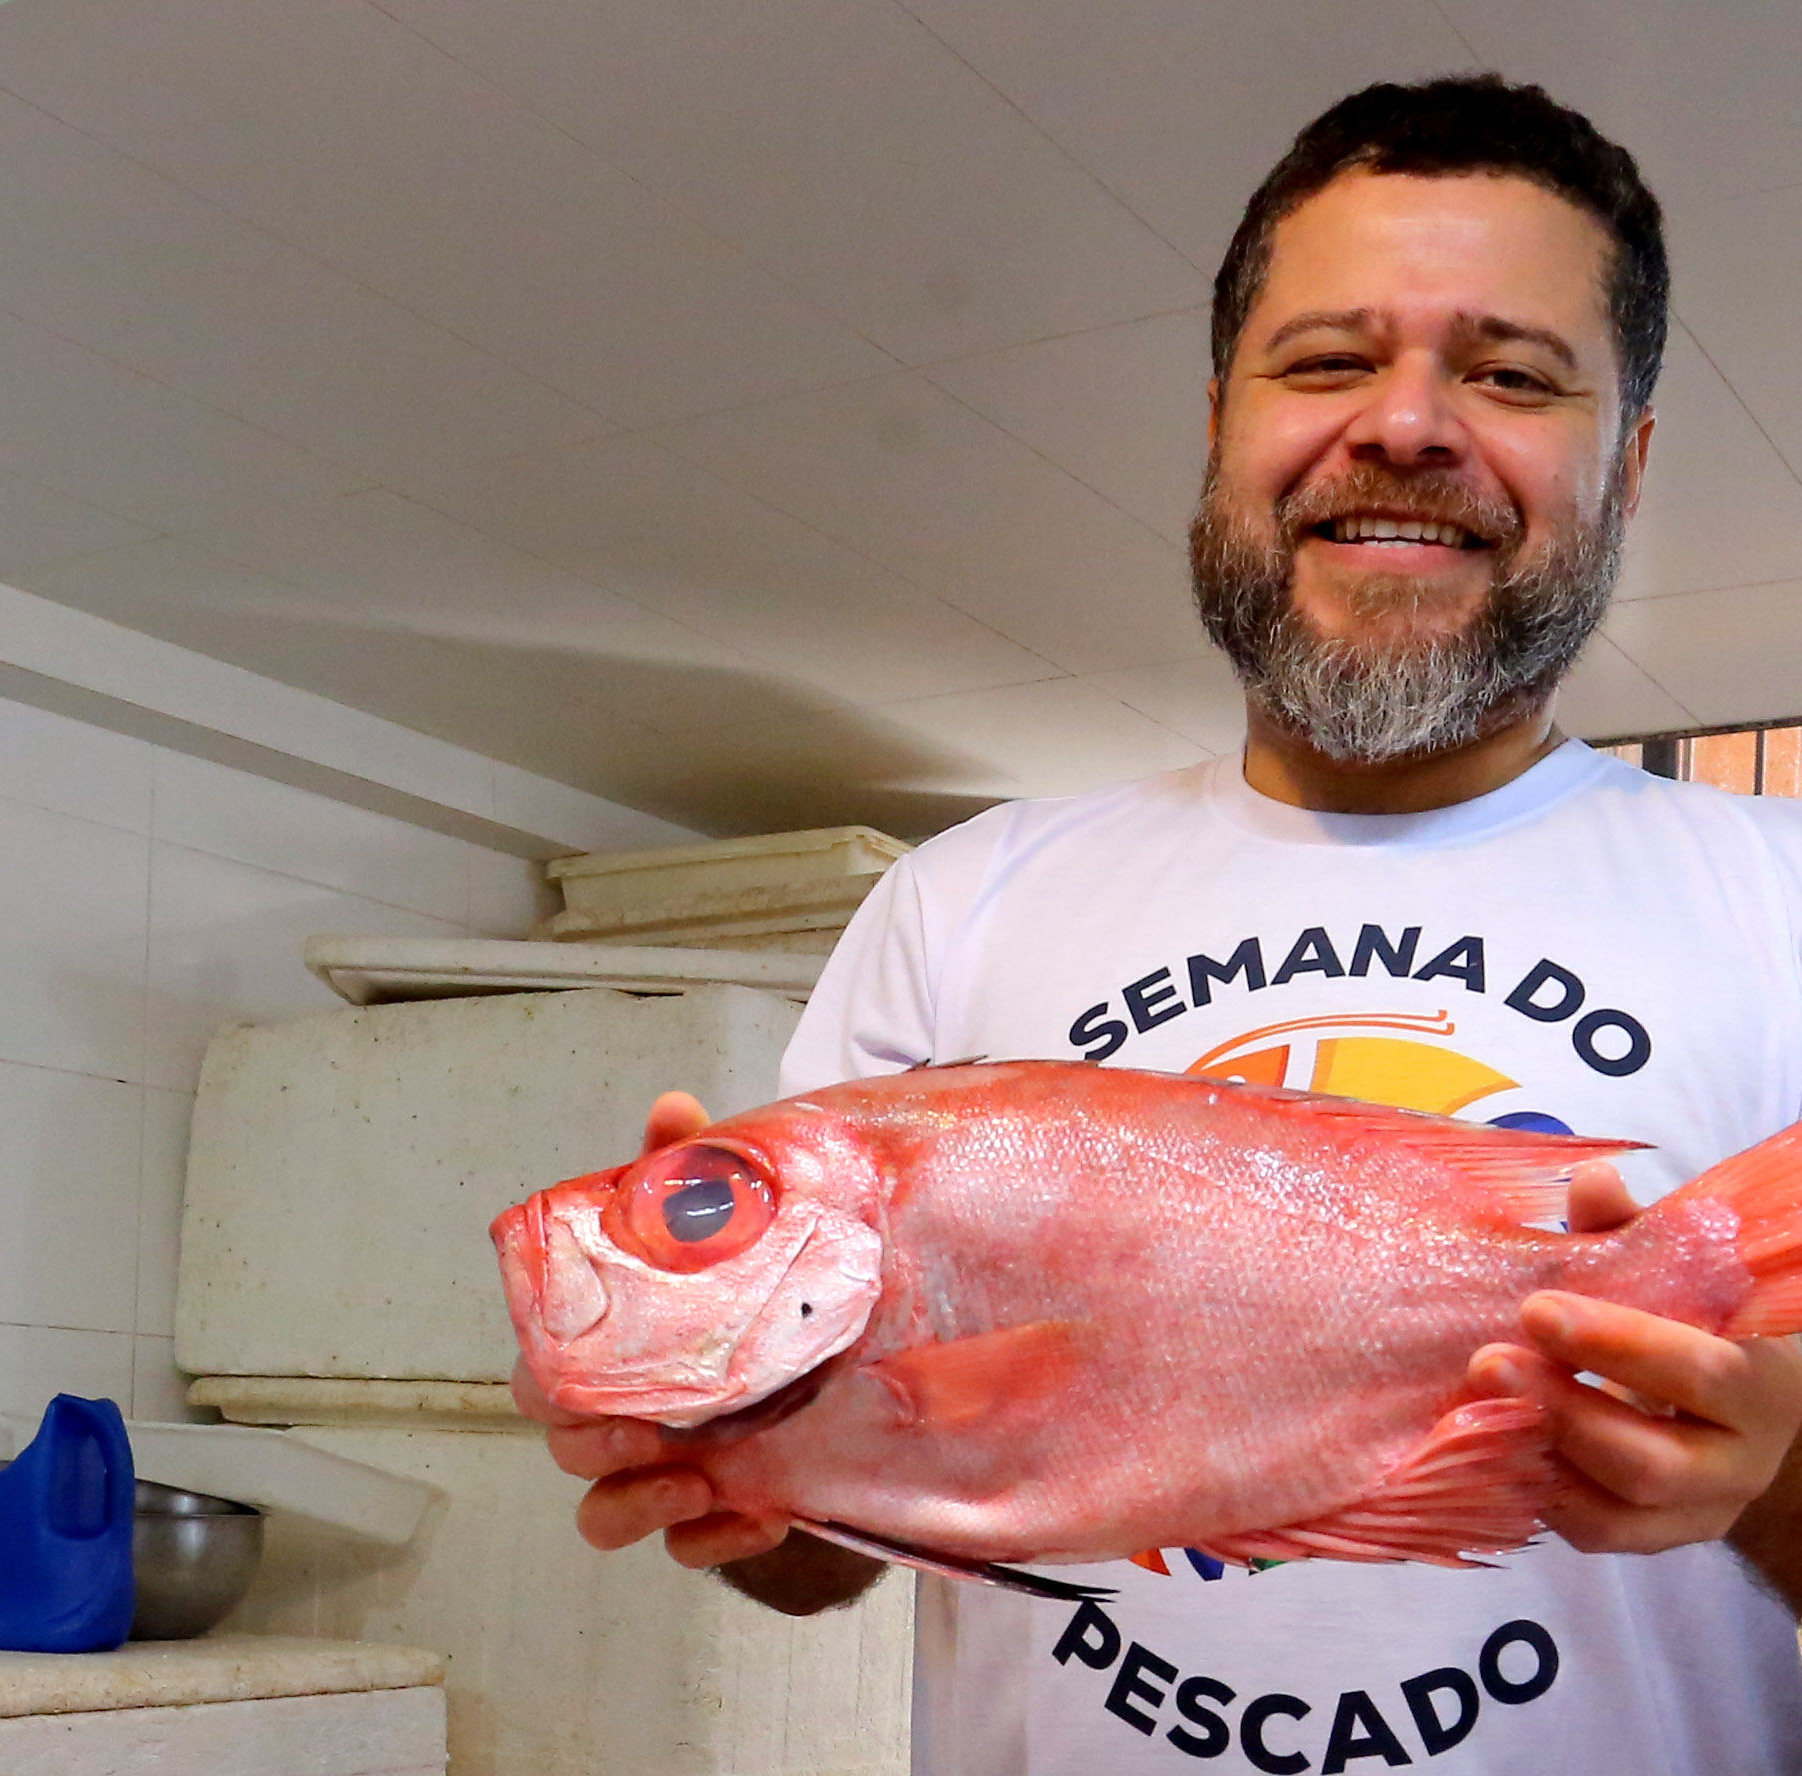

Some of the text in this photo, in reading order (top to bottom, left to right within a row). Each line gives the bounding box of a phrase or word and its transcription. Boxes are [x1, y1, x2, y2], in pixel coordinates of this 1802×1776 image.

[1068, 922, 1653, 1078] SEMANA DO
[1051, 1599, 1560, 1776] PESCADO
